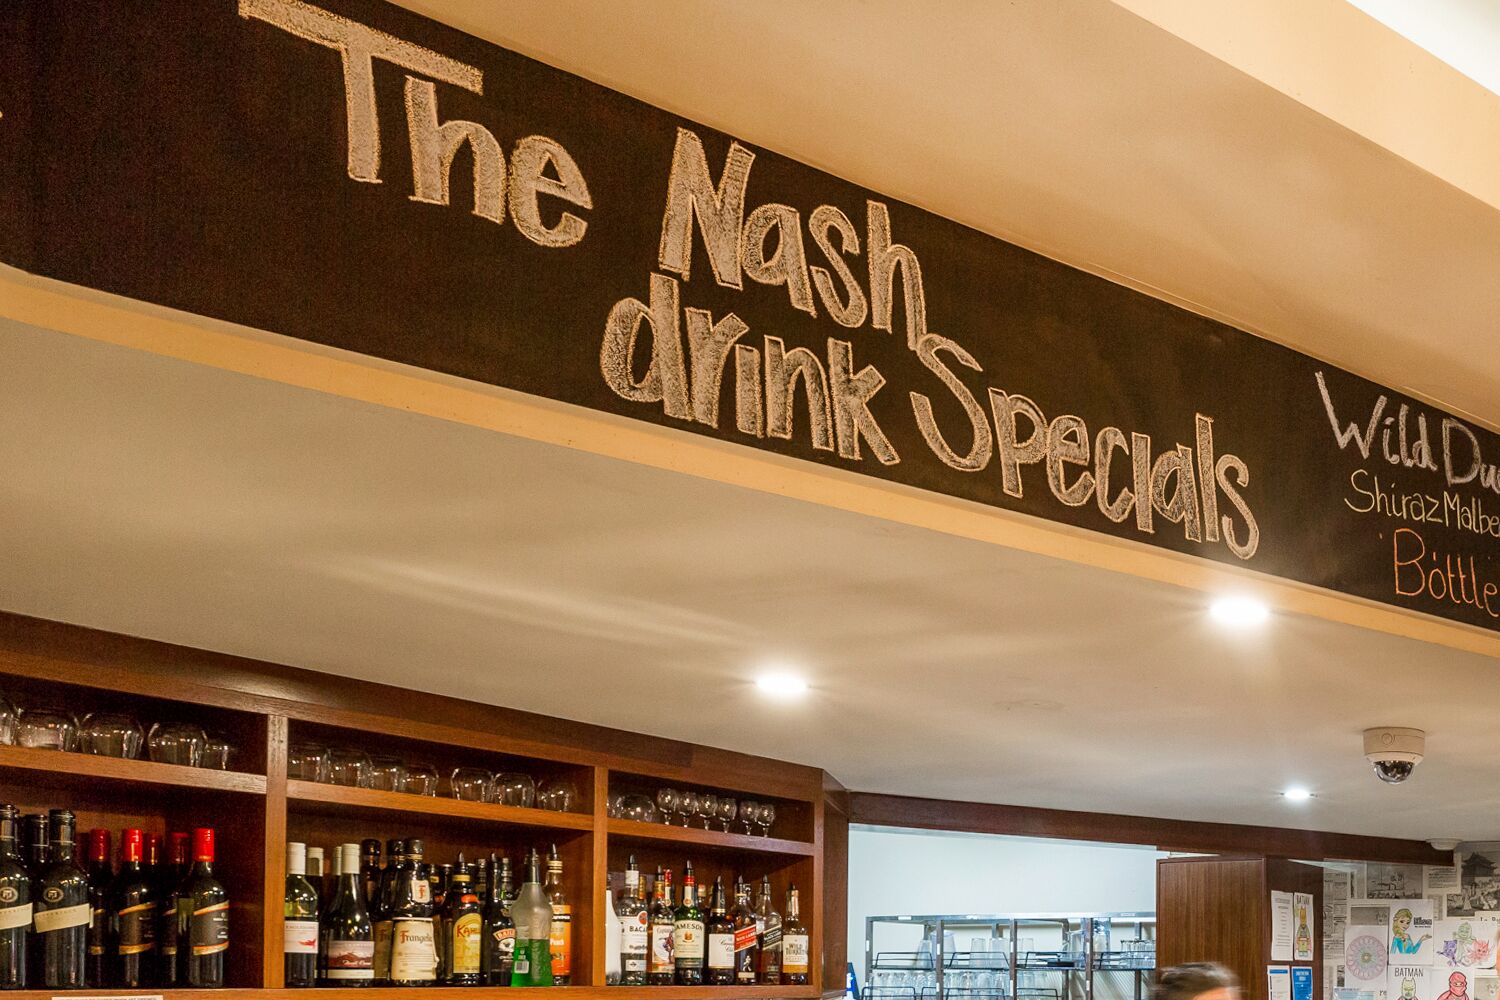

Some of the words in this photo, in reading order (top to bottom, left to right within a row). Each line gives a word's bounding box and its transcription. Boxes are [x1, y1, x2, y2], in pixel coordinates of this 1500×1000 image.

[239, 0, 592, 247] The
[658, 127, 926, 350] Nash
[600, 272, 901, 465] drink
[908, 334, 1260, 559] Specials
[1314, 371, 1438, 471] Wild
[1344, 470, 1443, 524] Shiraz
[1393, 528, 1499, 618] Bottle
[1394, 967, 1424, 977] BATMAN
